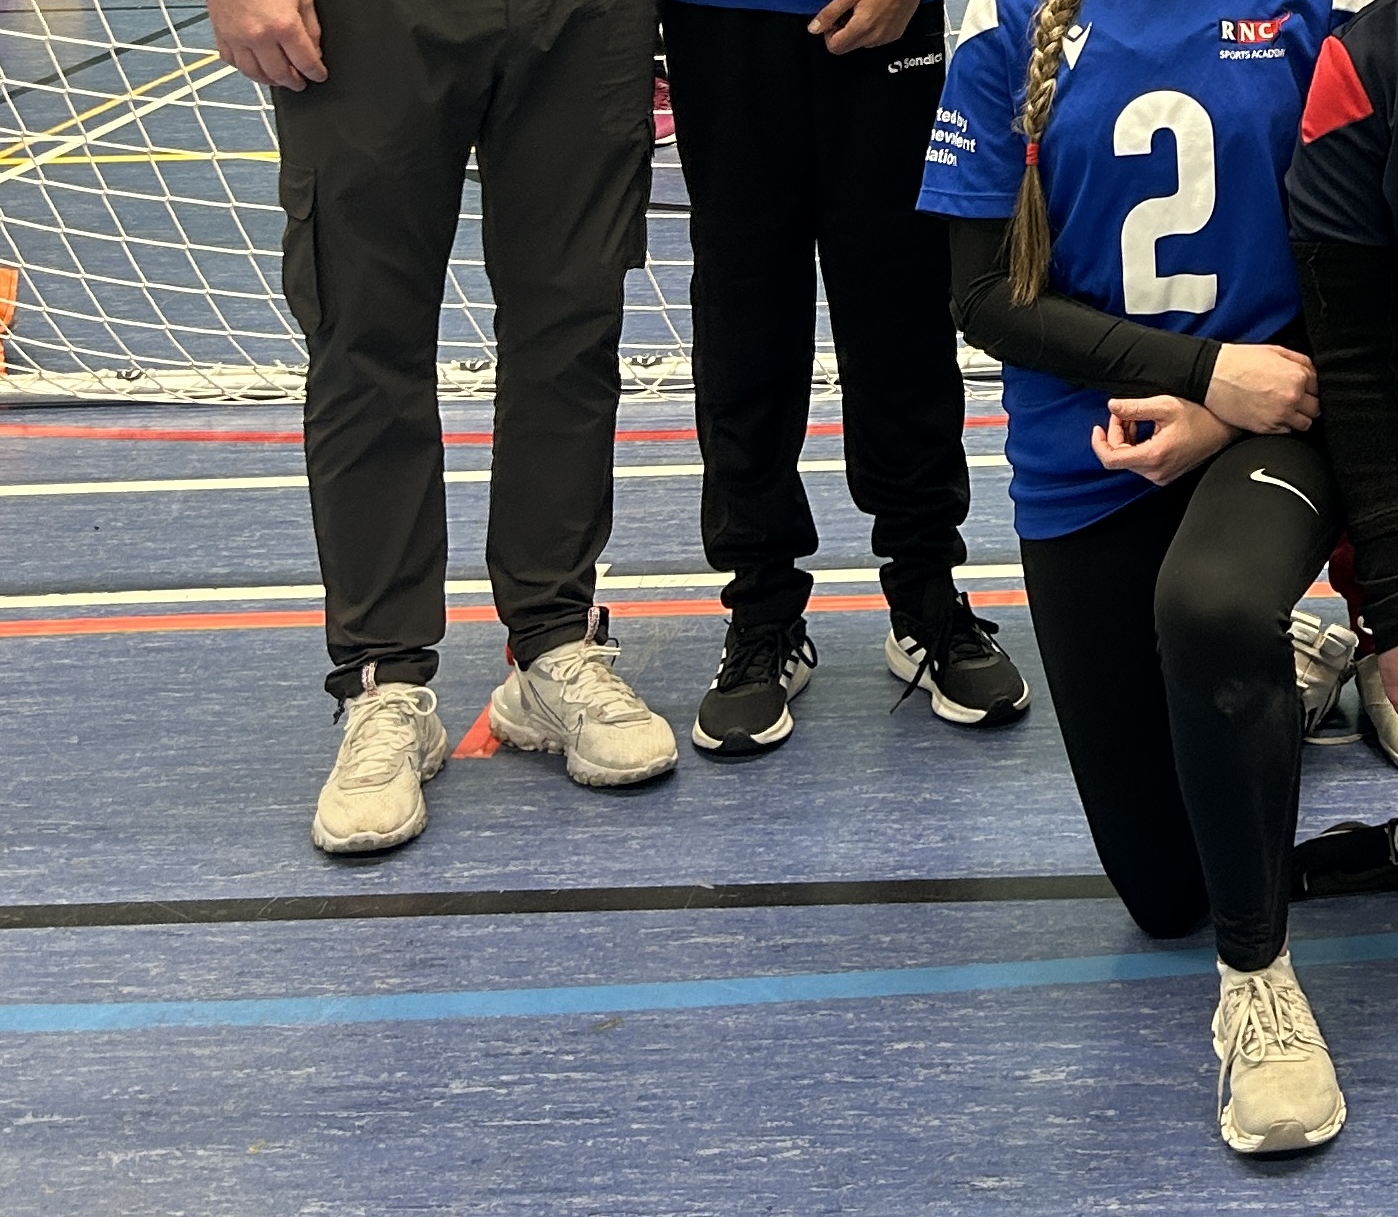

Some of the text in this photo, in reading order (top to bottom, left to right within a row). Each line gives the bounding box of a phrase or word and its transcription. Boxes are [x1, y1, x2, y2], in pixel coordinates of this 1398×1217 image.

[1221, 20, 1274, 42] RNC
[1219, 49, 1251, 60] SPORTS
[1112, 88, 1218, 316] 2
